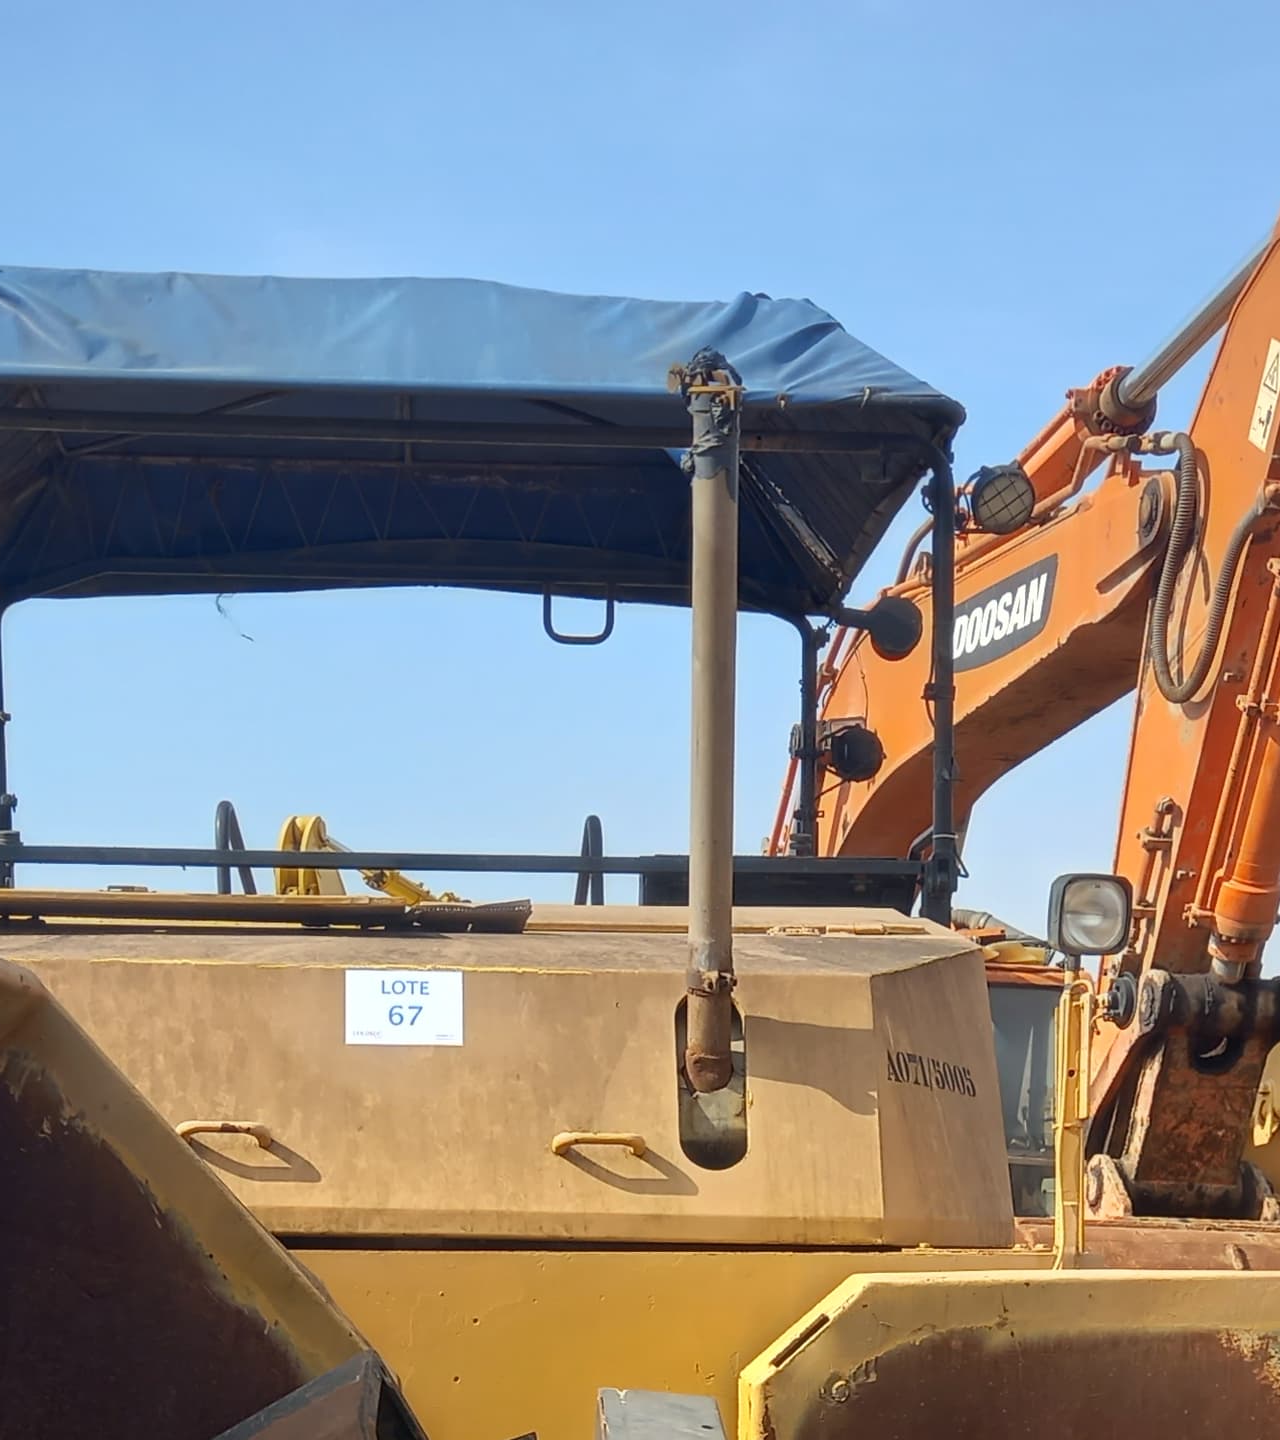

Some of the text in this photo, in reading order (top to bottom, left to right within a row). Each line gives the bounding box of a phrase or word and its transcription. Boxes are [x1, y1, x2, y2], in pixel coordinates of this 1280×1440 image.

[952, 572, 1048, 660] DOOSAN
[381, 979, 430, 995] LOTE
[388, 1004, 424, 1026] 67
[886, 1048, 976, 1098] A071/5005
